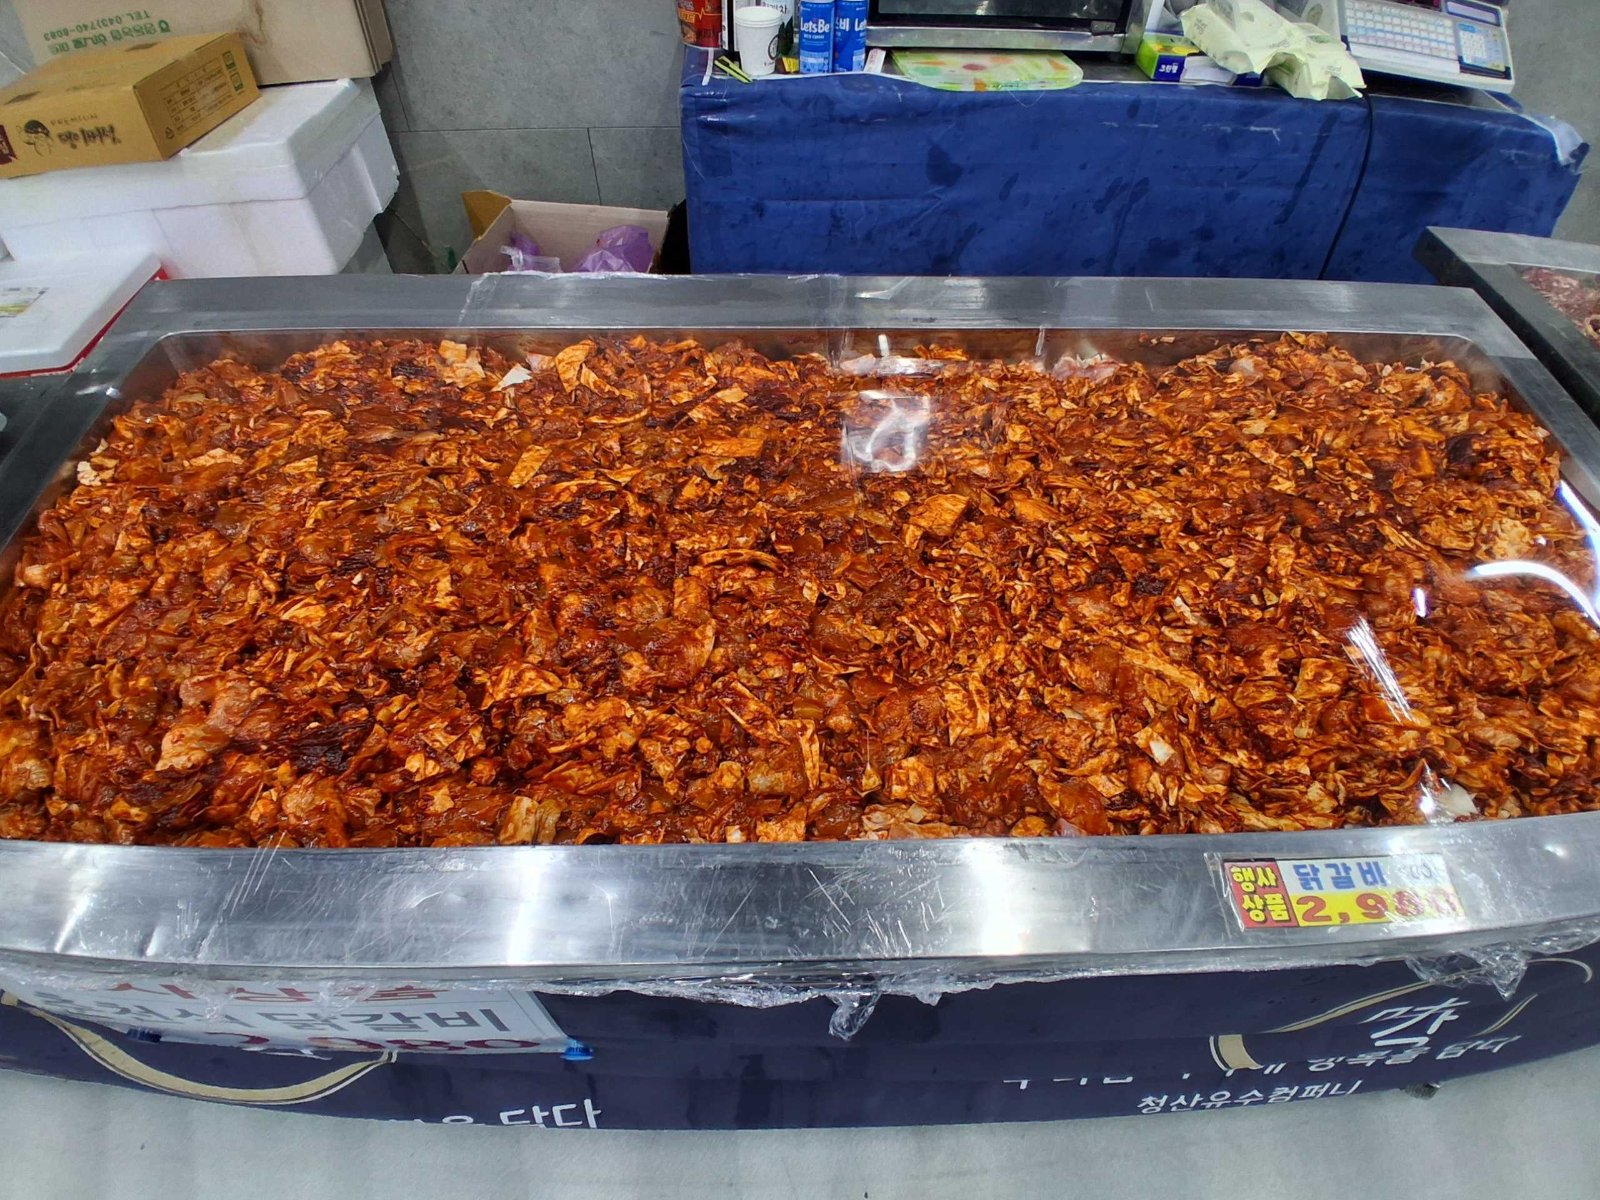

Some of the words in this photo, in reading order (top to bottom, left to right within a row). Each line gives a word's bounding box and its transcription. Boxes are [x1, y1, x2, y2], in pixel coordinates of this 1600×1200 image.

[1230, 865, 1279, 893] 행사
[1242, 893, 1290, 923] 상품
[257, 1008, 512, 1032] 닭갈비
[1136, 1080, 1364, 1114] 청산유수컴퍼니
